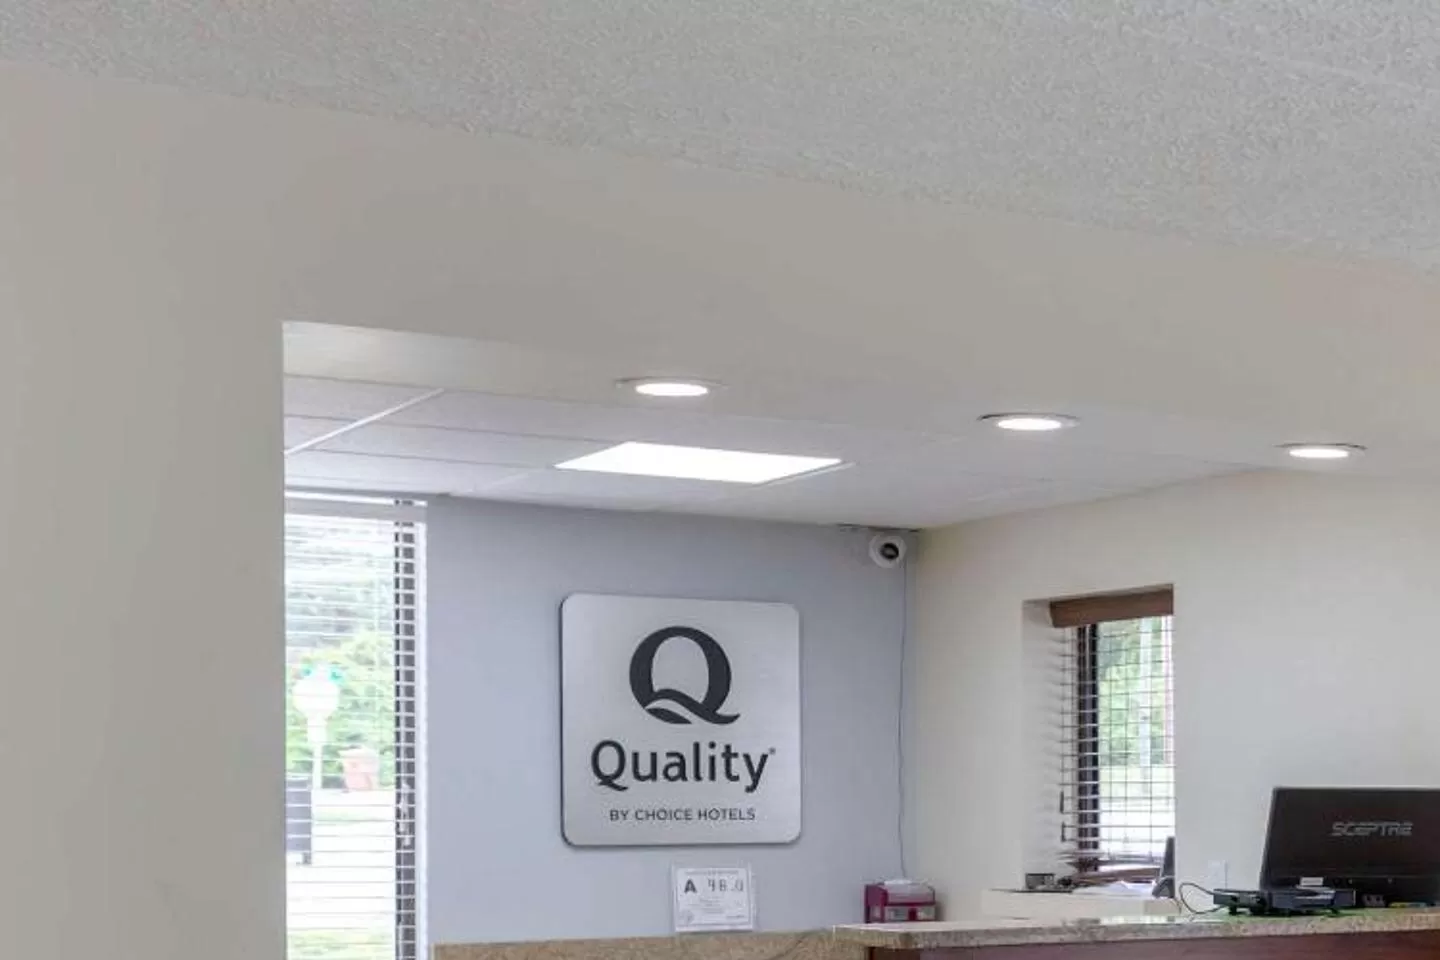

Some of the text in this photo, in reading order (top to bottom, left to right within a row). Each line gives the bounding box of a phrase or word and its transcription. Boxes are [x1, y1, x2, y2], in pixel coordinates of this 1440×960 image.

[591, 740, 769, 793] Quality
[609, 808, 757, 822] BY CHOICE HOTELS
[1331, 821, 1414, 837] SCEPTRE
[683, 879, 698, 893] A
